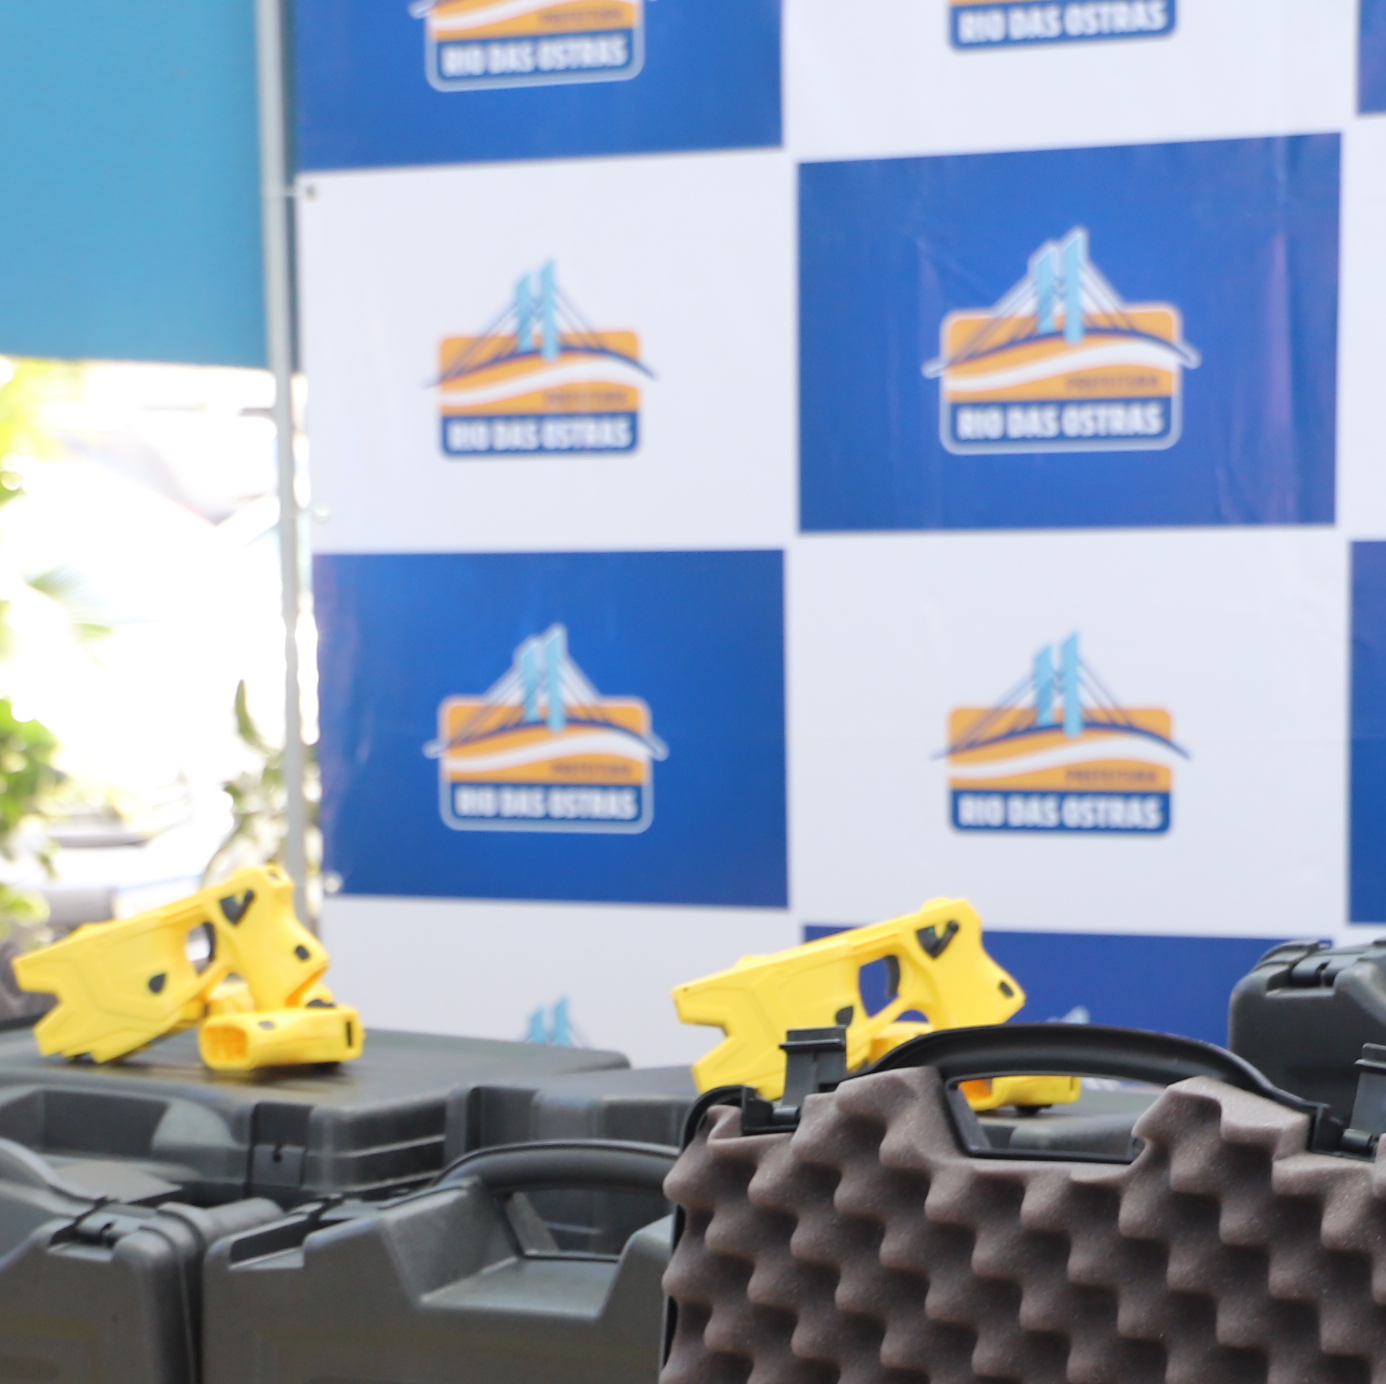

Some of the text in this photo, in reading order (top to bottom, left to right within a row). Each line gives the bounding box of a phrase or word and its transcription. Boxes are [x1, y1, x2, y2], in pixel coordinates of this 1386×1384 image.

[958, 0, 1168, 44] RIO DAS OSTRAS
[441, 34, 628, 77] RIO DAS OSTRAS
[448, 417, 632, 452] RIO DAS OSTRAS
[957, 402, 1164, 440] RIO DAS OSTRAS
[454, 786, 638, 820] RIO DAS OSTRAS
[958, 794, 1163, 830] RIO DAS OSTRAS
